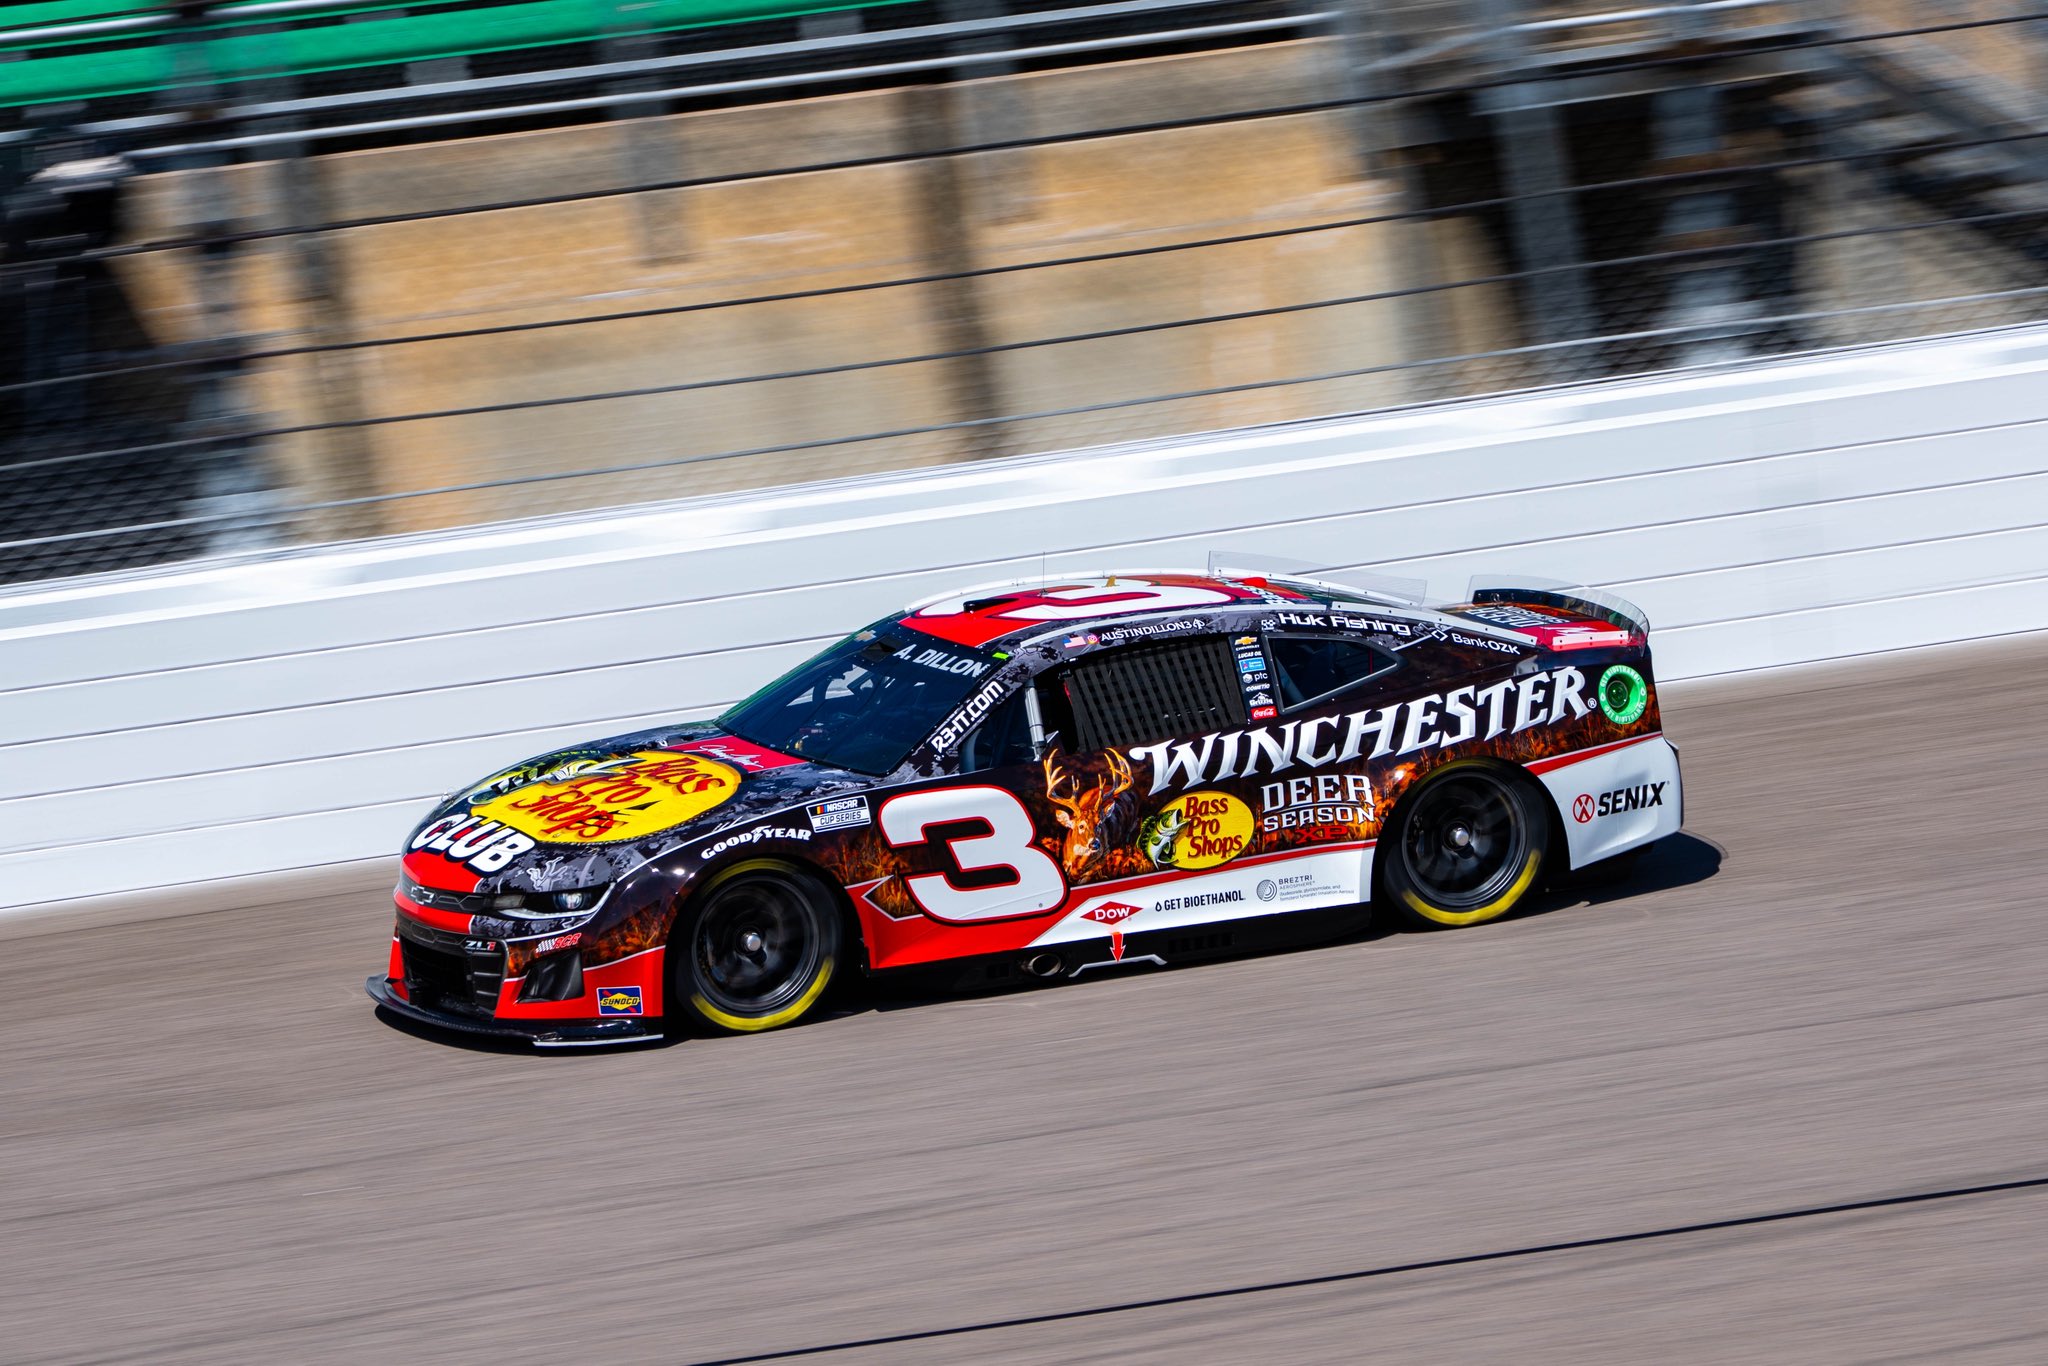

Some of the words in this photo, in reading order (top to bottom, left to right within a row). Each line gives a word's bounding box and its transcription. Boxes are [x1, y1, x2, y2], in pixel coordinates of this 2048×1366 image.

[1101, 620, 1192, 641] AUSTINDILLON3
[1278, 613, 1327, 627] Huk
[1331, 615, 1411, 636] Fishing
[893, 644, 911, 661] A.
[913, 649, 988, 678] DILLON
[1254, 672, 1268, 681] ptc
[1260, 775, 1375, 813] DEER
[1597, 781, 1666, 817] SENIX
[826, 799, 859, 813] NASCAR
[1184, 796, 1228, 818] Bass
[820, 815, 834, 826] CUP
[835, 811, 862, 823] SERIES
[1186, 817, 1220, 837] Pro
[1264, 807, 1374, 832] SEASON
[411, 813, 535, 872] CLUB
[701, 825, 812, 860] GOODYEAR
[1295, 825, 1349, 844] XP
[878, 784, 1067, 924] 3
[1188, 835, 1242, 858] Shops
[1279, 875, 1312, 885] BREZTRI
[1164, 898, 1181, 911] GET
[1184, 890, 1244, 909] BIOETHANOL
[465, 940, 496, 951] ZL1
[602, 997, 638, 1006] SUNOCO
